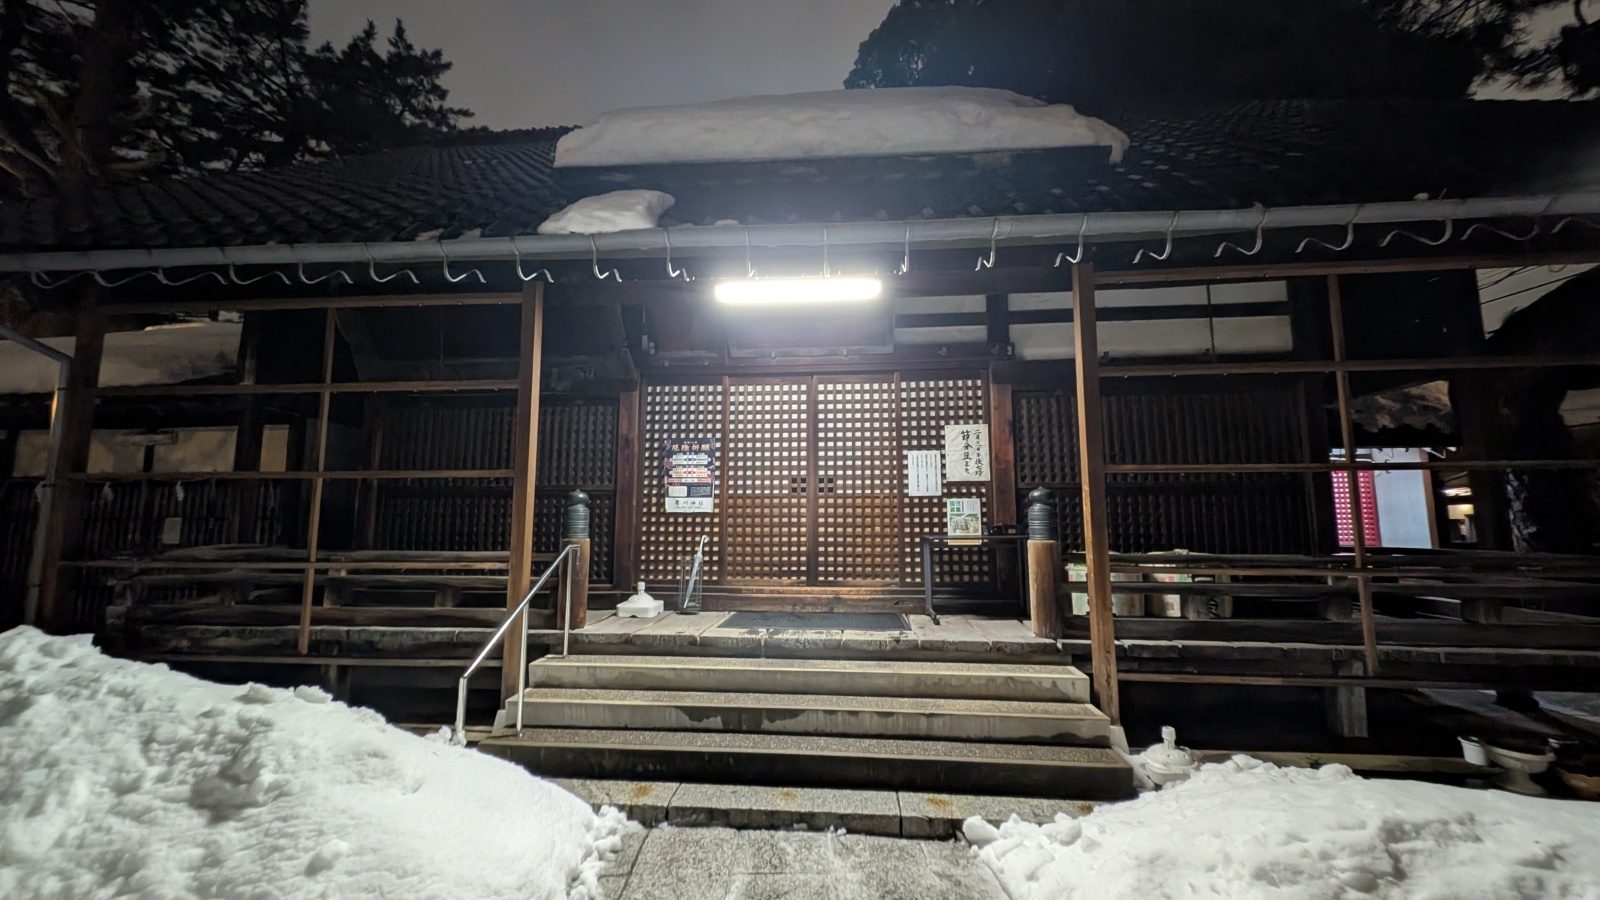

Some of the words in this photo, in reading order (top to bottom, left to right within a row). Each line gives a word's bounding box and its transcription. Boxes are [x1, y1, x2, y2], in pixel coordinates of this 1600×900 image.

[961, 430, 973, 474] 節分豆まき
